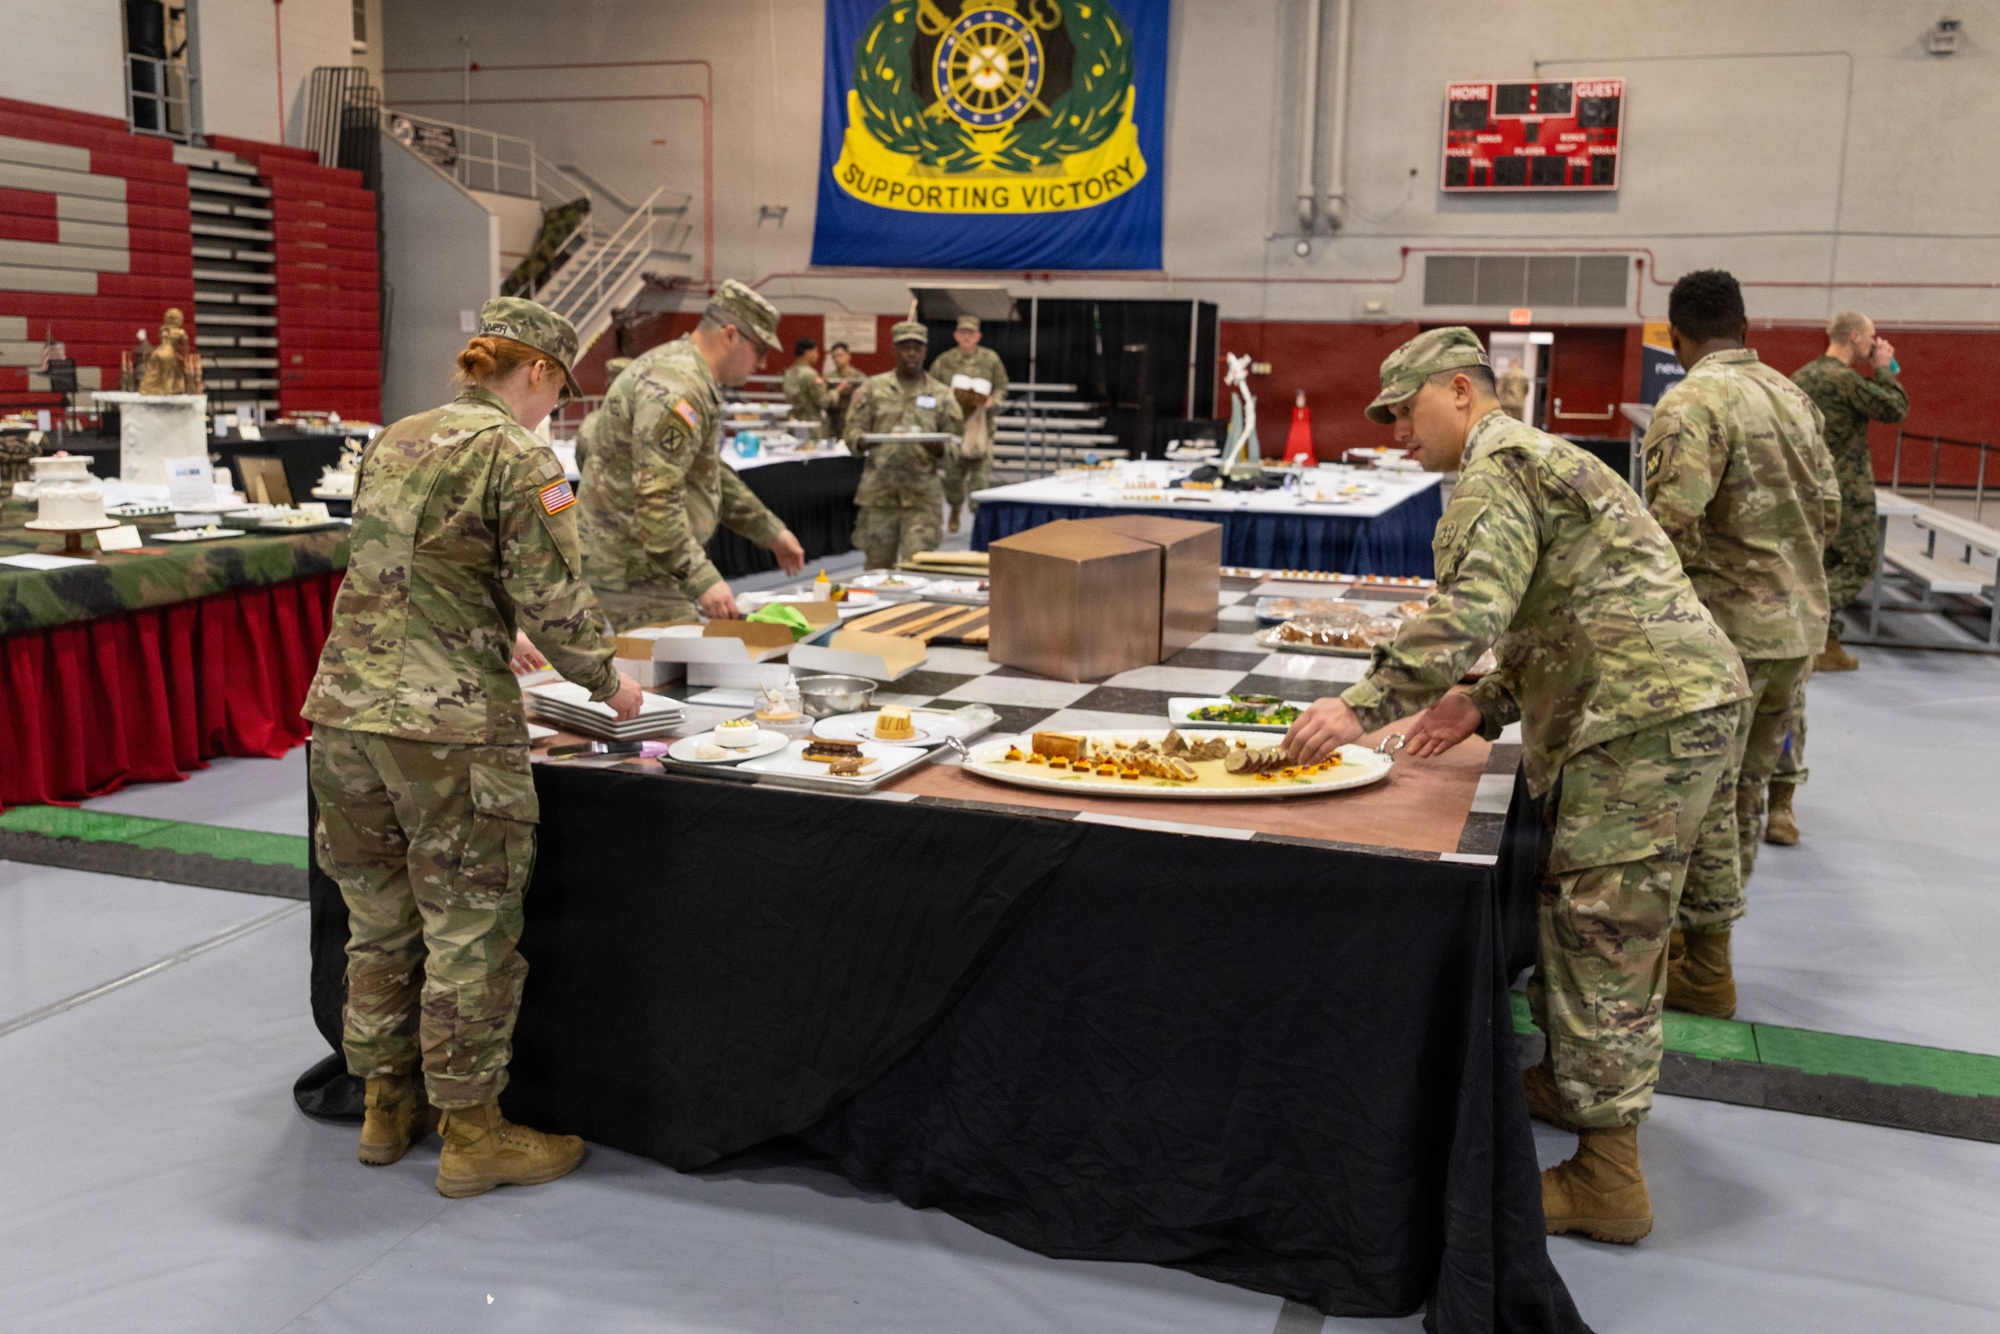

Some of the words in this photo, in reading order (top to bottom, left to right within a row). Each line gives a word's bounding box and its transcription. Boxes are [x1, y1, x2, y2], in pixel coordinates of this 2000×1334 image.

[1450, 86, 1489, 100] HOME
[1576, 83, 1620, 97] GUEST
[843, 162, 1009, 208] SUPPORTING
[1022, 156, 1136, 208] VICTORY
